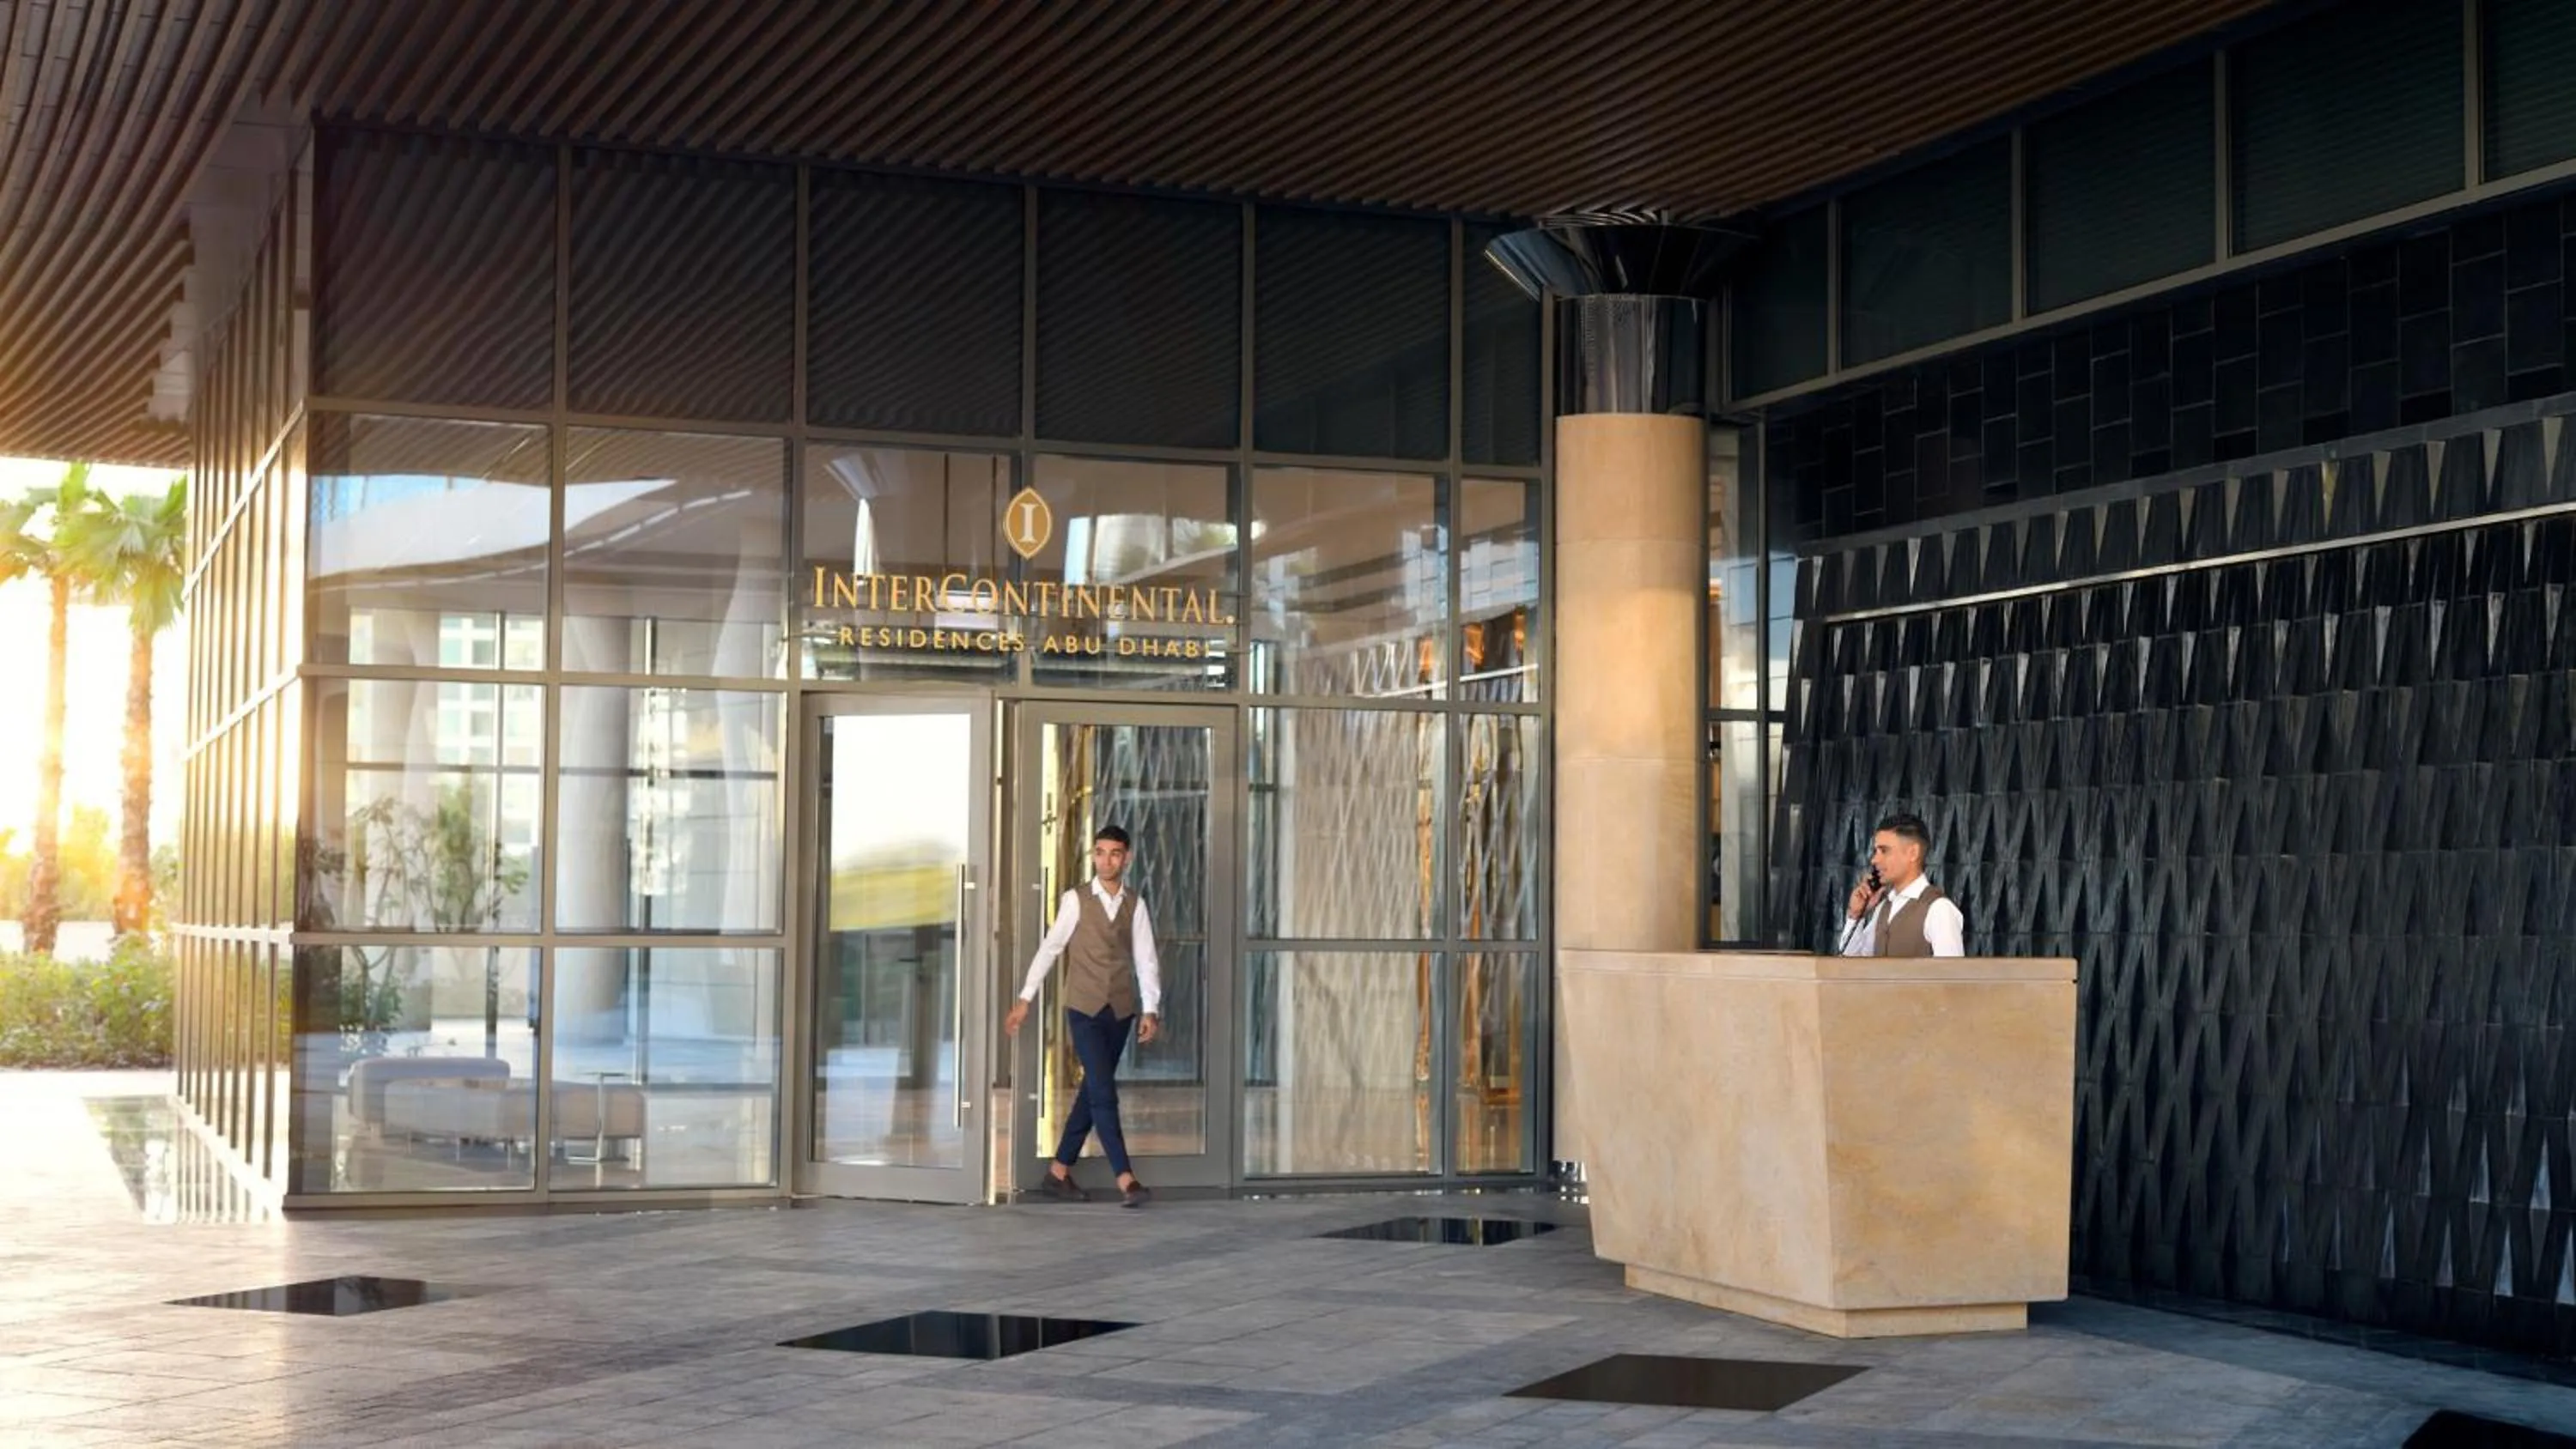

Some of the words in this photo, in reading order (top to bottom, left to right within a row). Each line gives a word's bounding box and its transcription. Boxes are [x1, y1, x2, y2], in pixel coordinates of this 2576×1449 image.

[1018, 501, 1040, 543] I
[814, 566, 1225, 625] INTERCONTINENTAL
[839, 627, 1025, 652] RESIDENCES
[1043, 635, 1101, 655] ABU
[1119, 637, 1210, 658] DHABI
